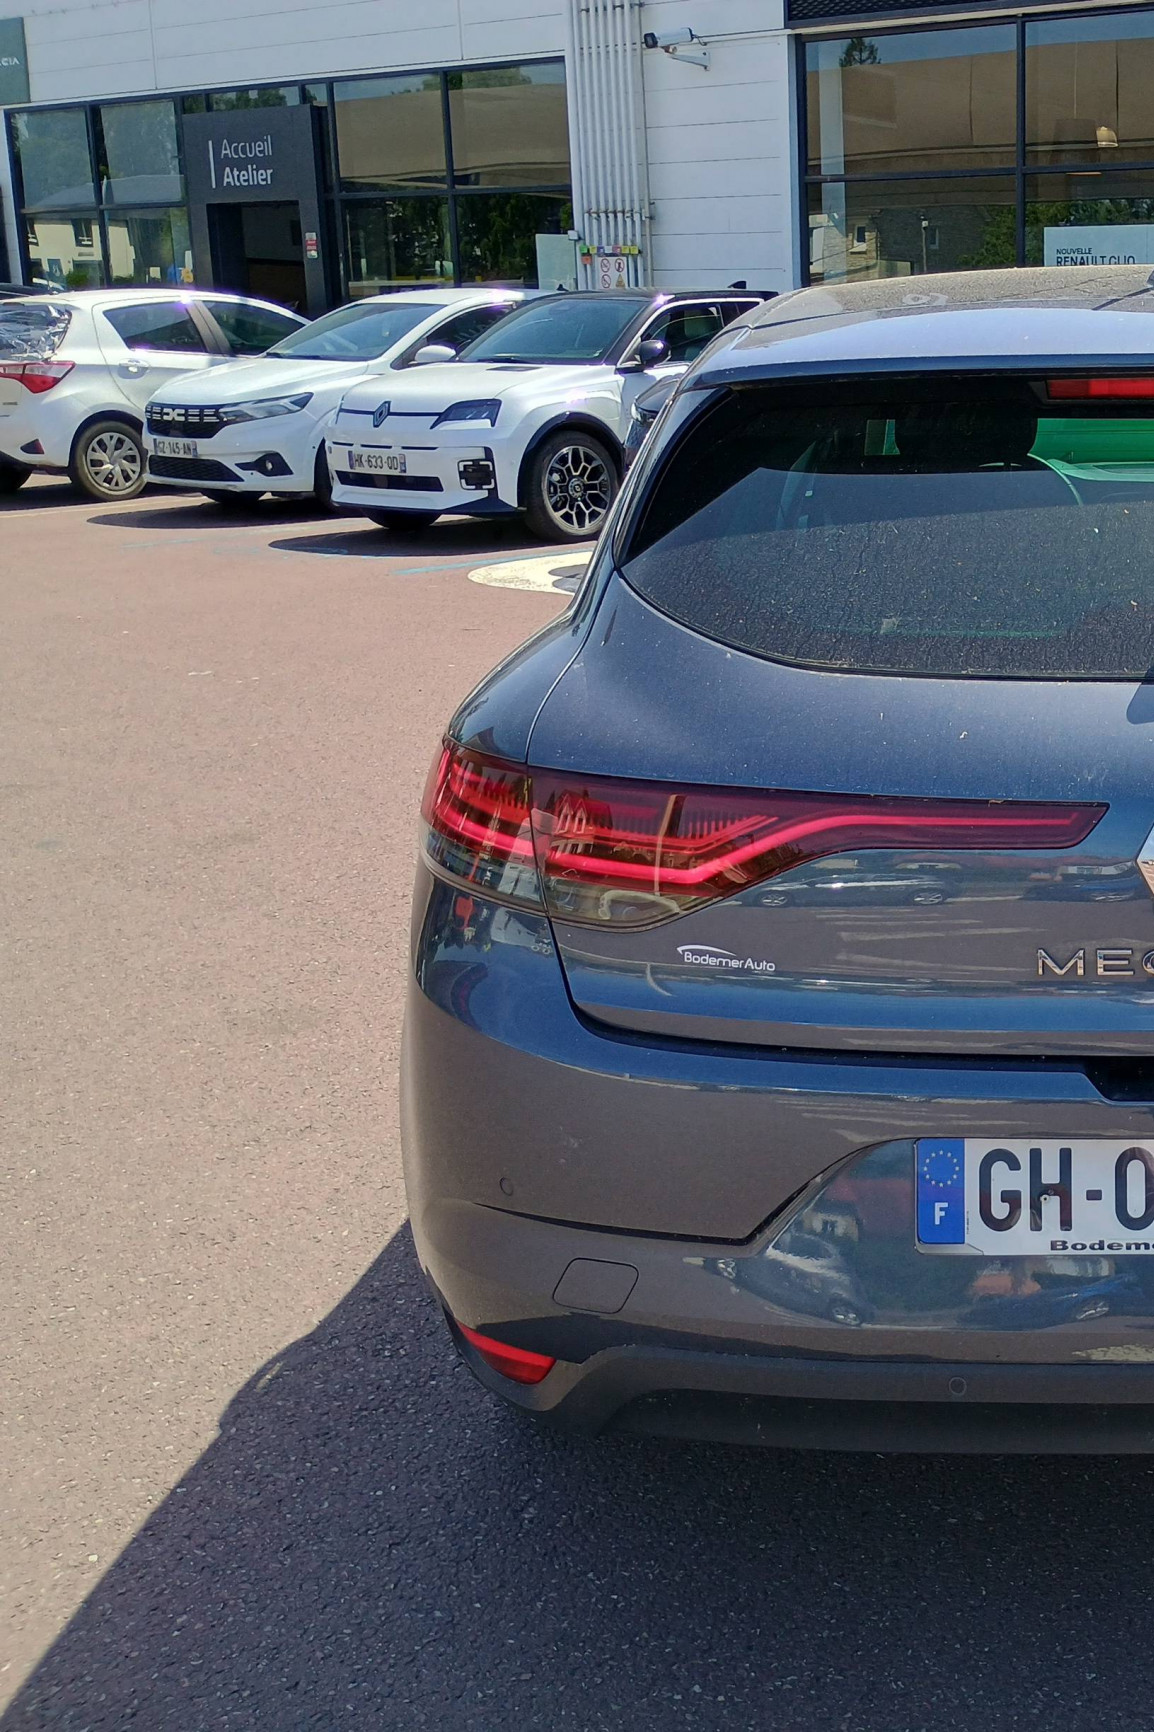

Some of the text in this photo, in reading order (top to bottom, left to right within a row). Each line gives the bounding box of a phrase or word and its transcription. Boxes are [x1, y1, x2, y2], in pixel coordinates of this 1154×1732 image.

[0, 57, 20, 66] CIA
[220, 134, 273, 159] Accueil
[223, 164, 273, 187] Atelier
[1056, 247, 1092, 255] NOUVELLE
[1056, 255, 1106, 266] RENAULT
[684, 951, 776, 972] BodemerAuto
[934, 1201, 949, 1225] F
